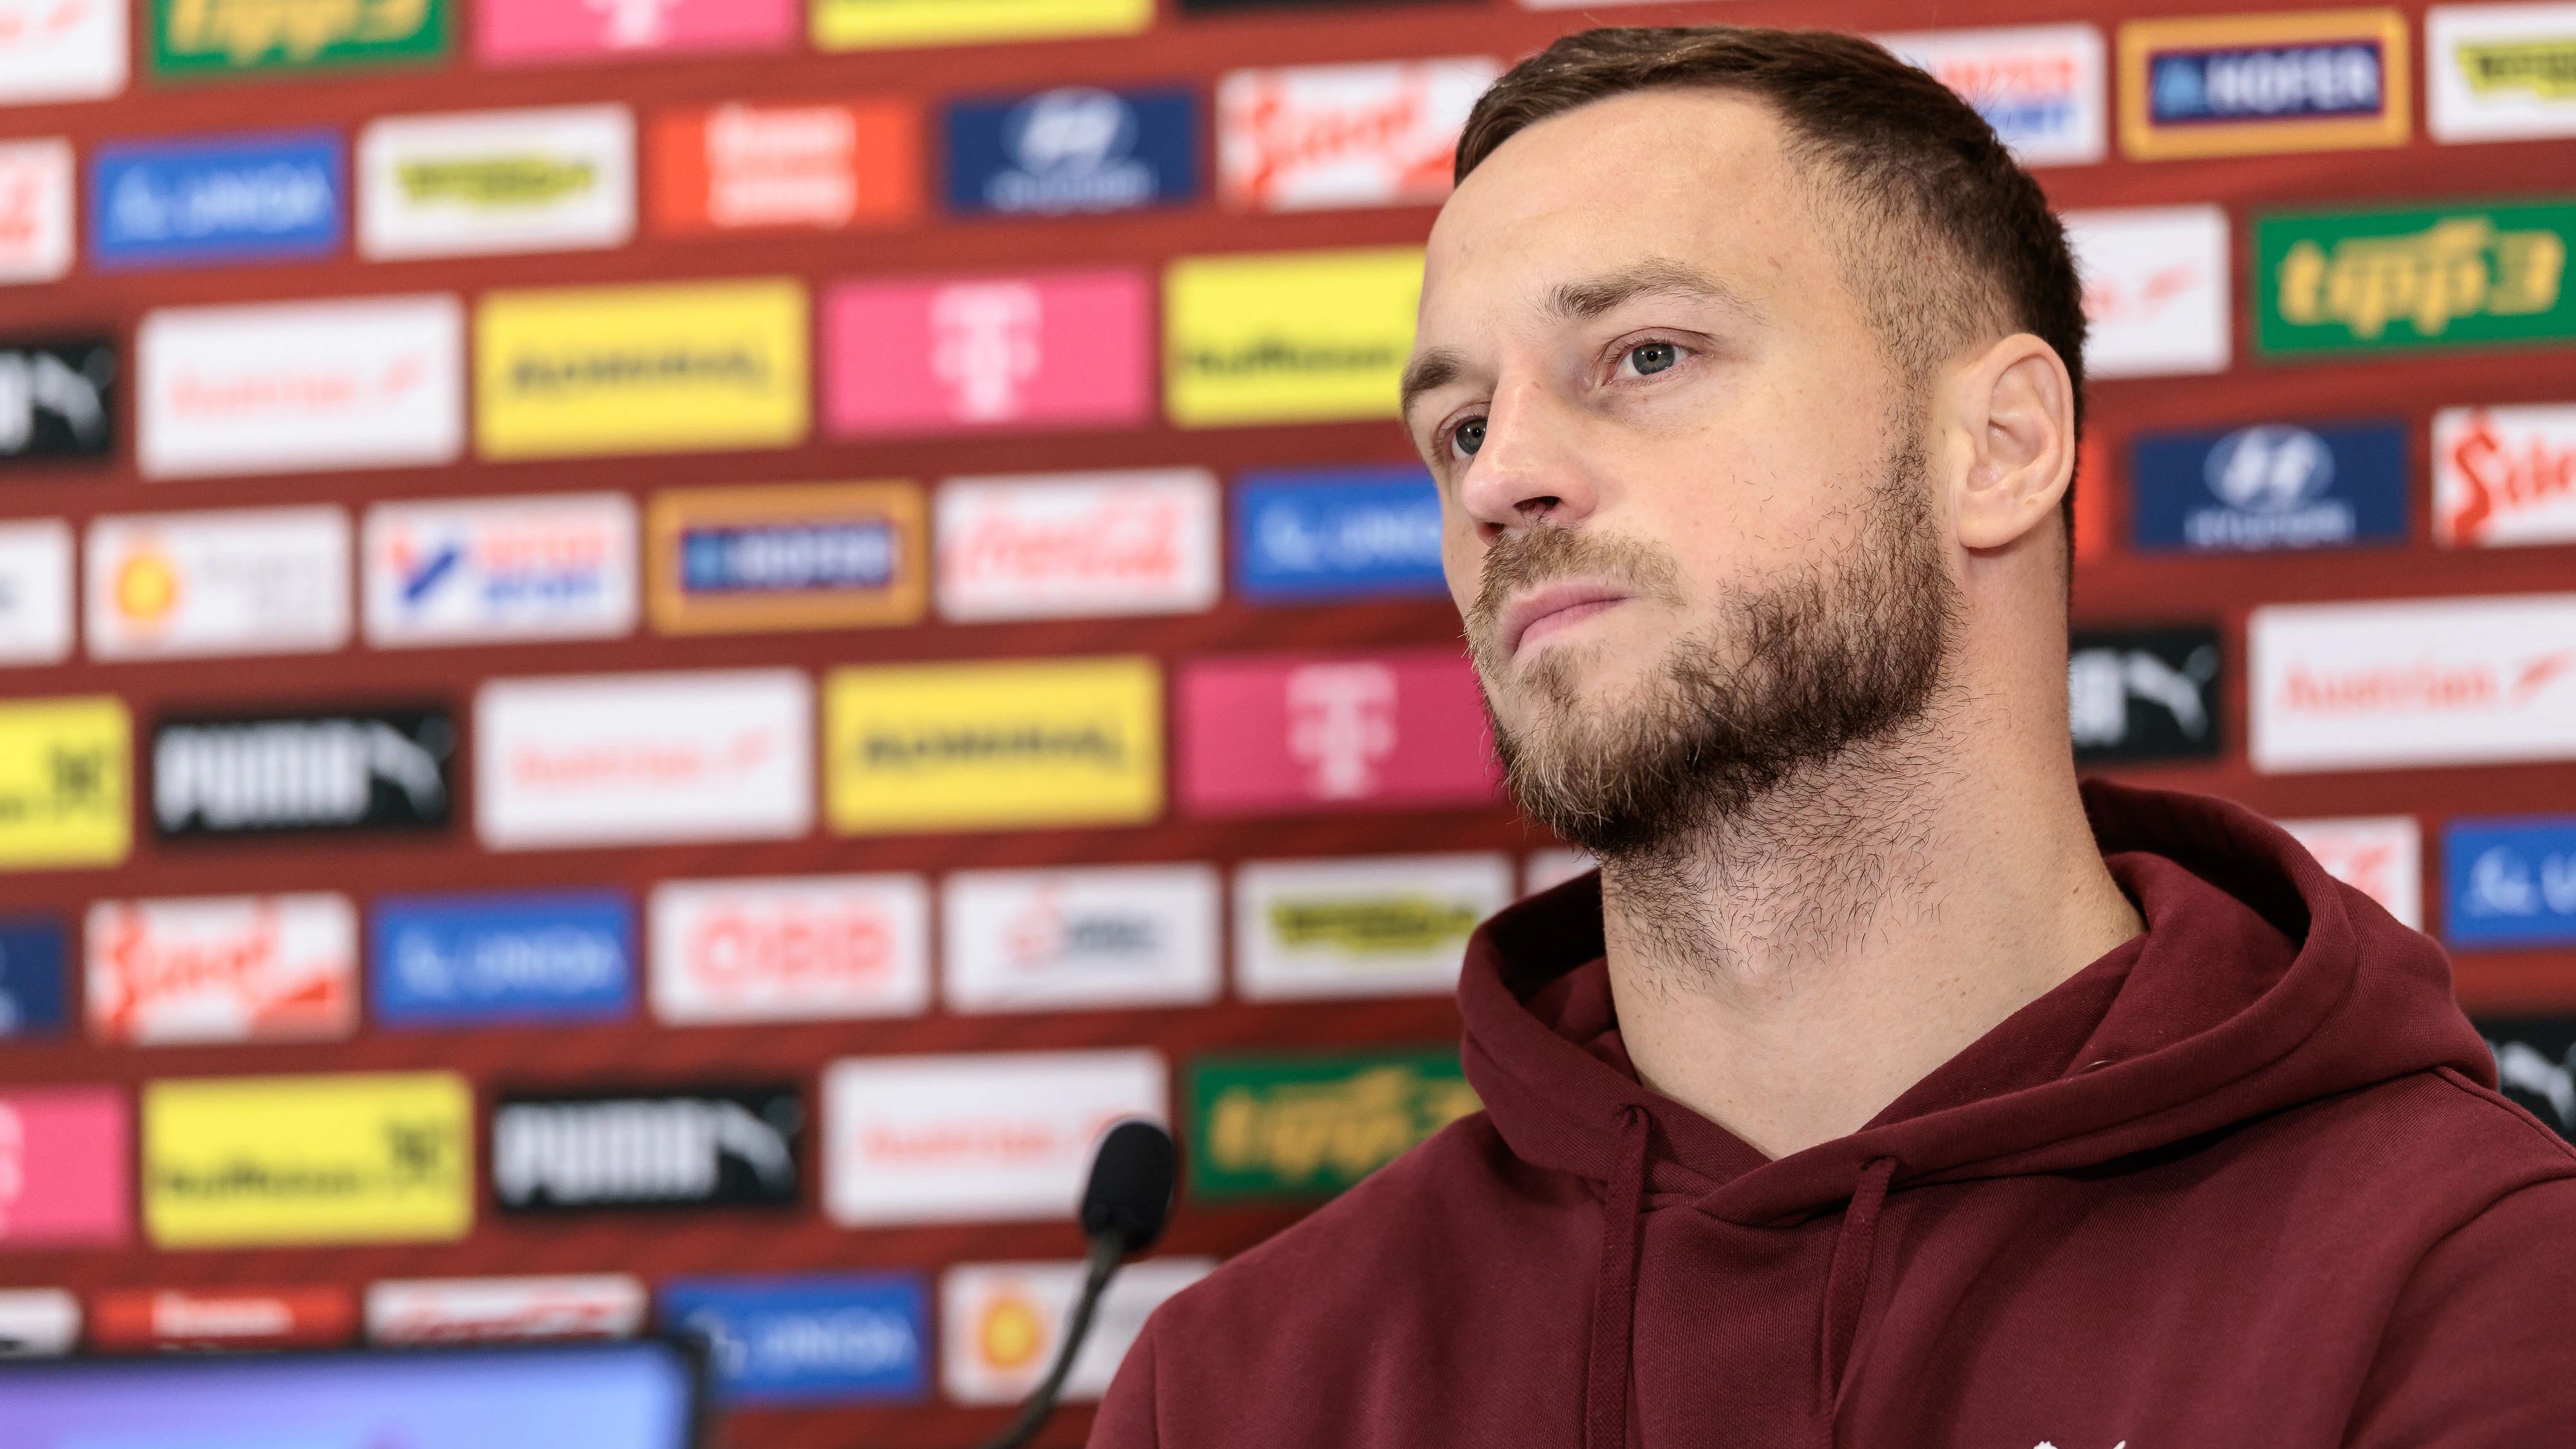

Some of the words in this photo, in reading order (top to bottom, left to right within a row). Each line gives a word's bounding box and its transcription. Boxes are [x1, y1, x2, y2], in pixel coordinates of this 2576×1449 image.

[2206, 46, 2379, 115] HOFER
[2280, 218, 2564, 337] tipp3
[2282, 662, 2497, 714] Austrian
